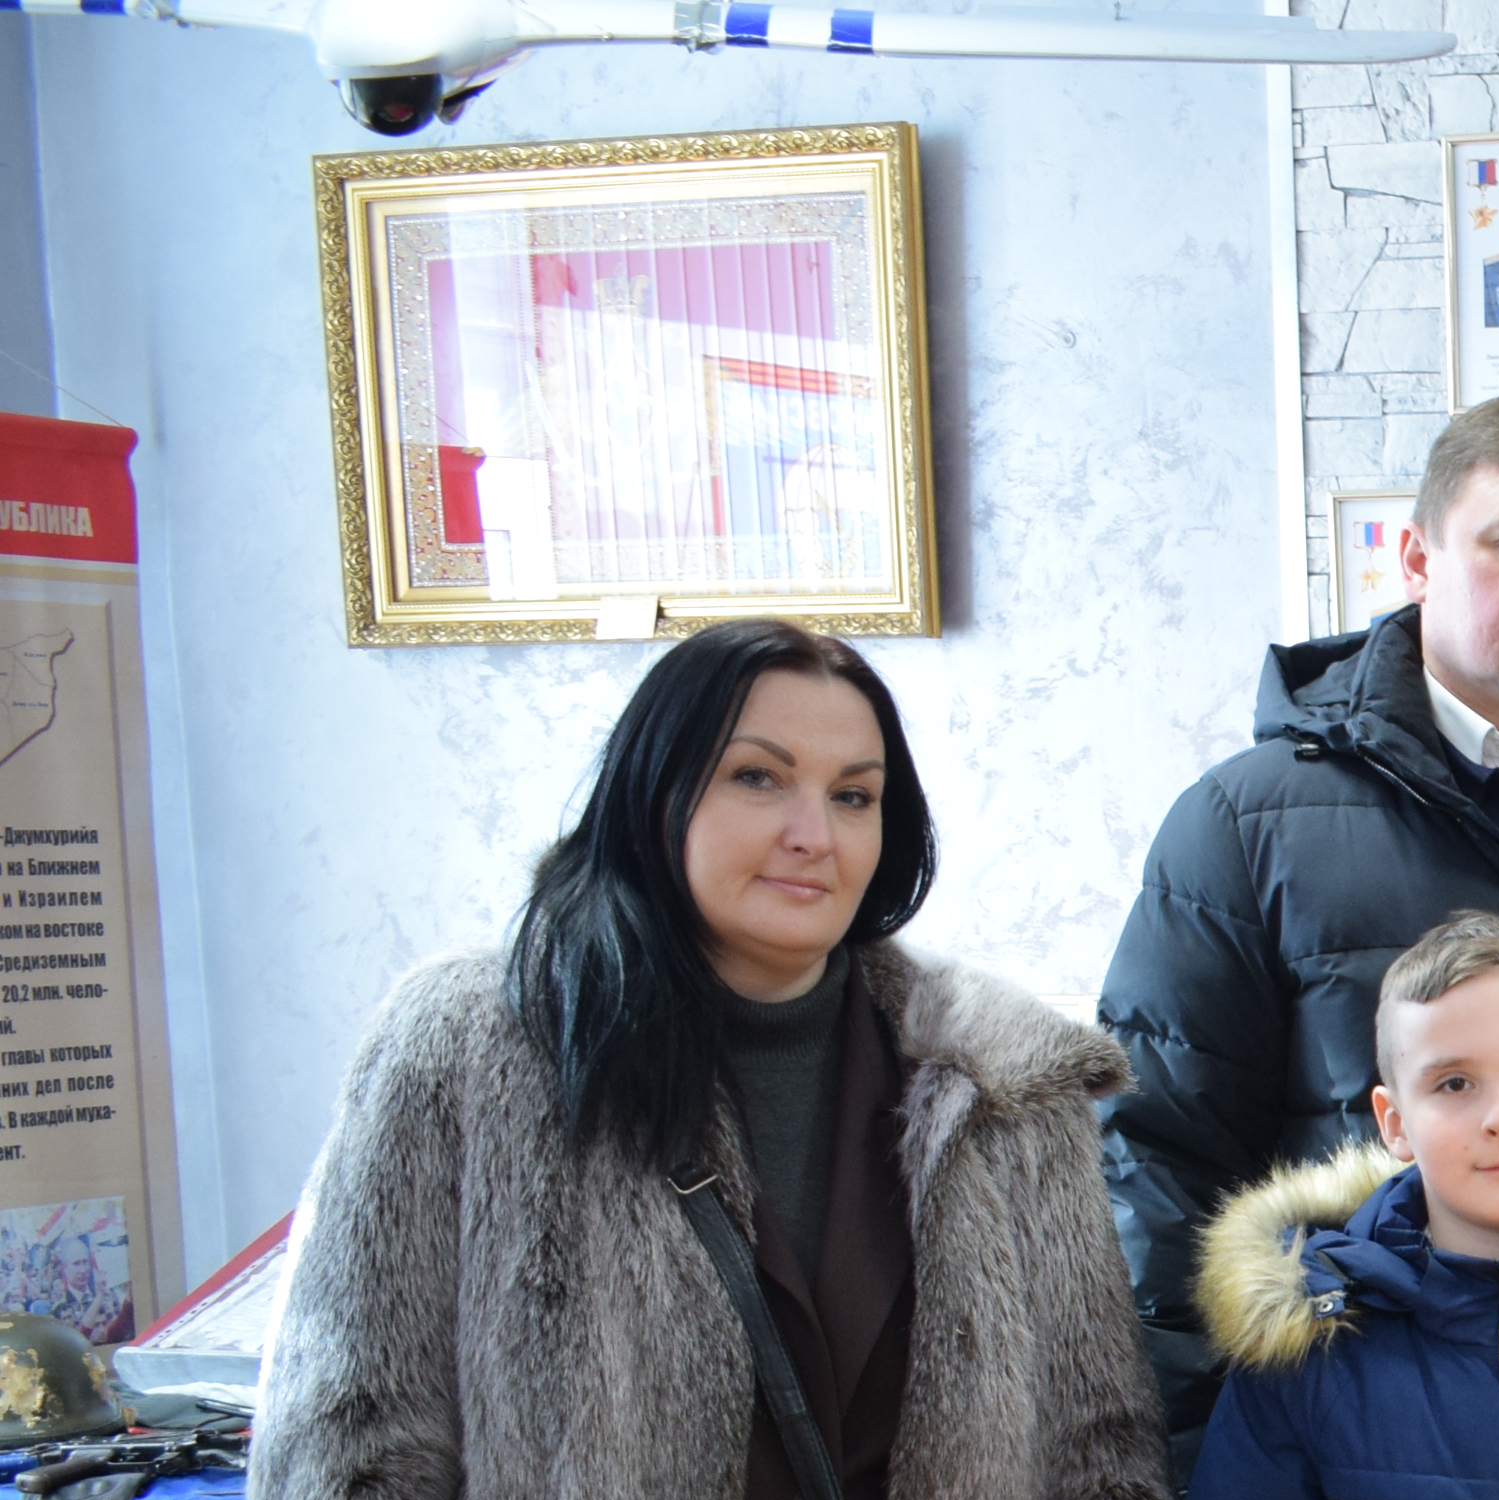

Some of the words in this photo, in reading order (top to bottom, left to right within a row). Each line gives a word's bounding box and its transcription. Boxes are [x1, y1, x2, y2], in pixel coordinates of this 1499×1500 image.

[8, 861, 23, 876] на
[28, 858, 100, 876] Ближнем
[3, 893, 12, 908] и
[18, 890, 102, 909] Израилем
[25, 924, 41, 939] на
[44, 921, 104, 938] востоке
[2, 984, 29, 1004] 20,2
[32, 986, 63, 1001] млн.
[66, 982, 108, 999] чело-
[2, 1049, 45, 1066] главы
[50, 1044, 112, 1063] которых
[36, 1078, 61, 1097] дел
[68, 1074, 114, 1092] после
[8, 1111, 17, 1129] В
[20, 1105, 73, 1128] каждой
[76, 1104, 116, 1123] муха-
